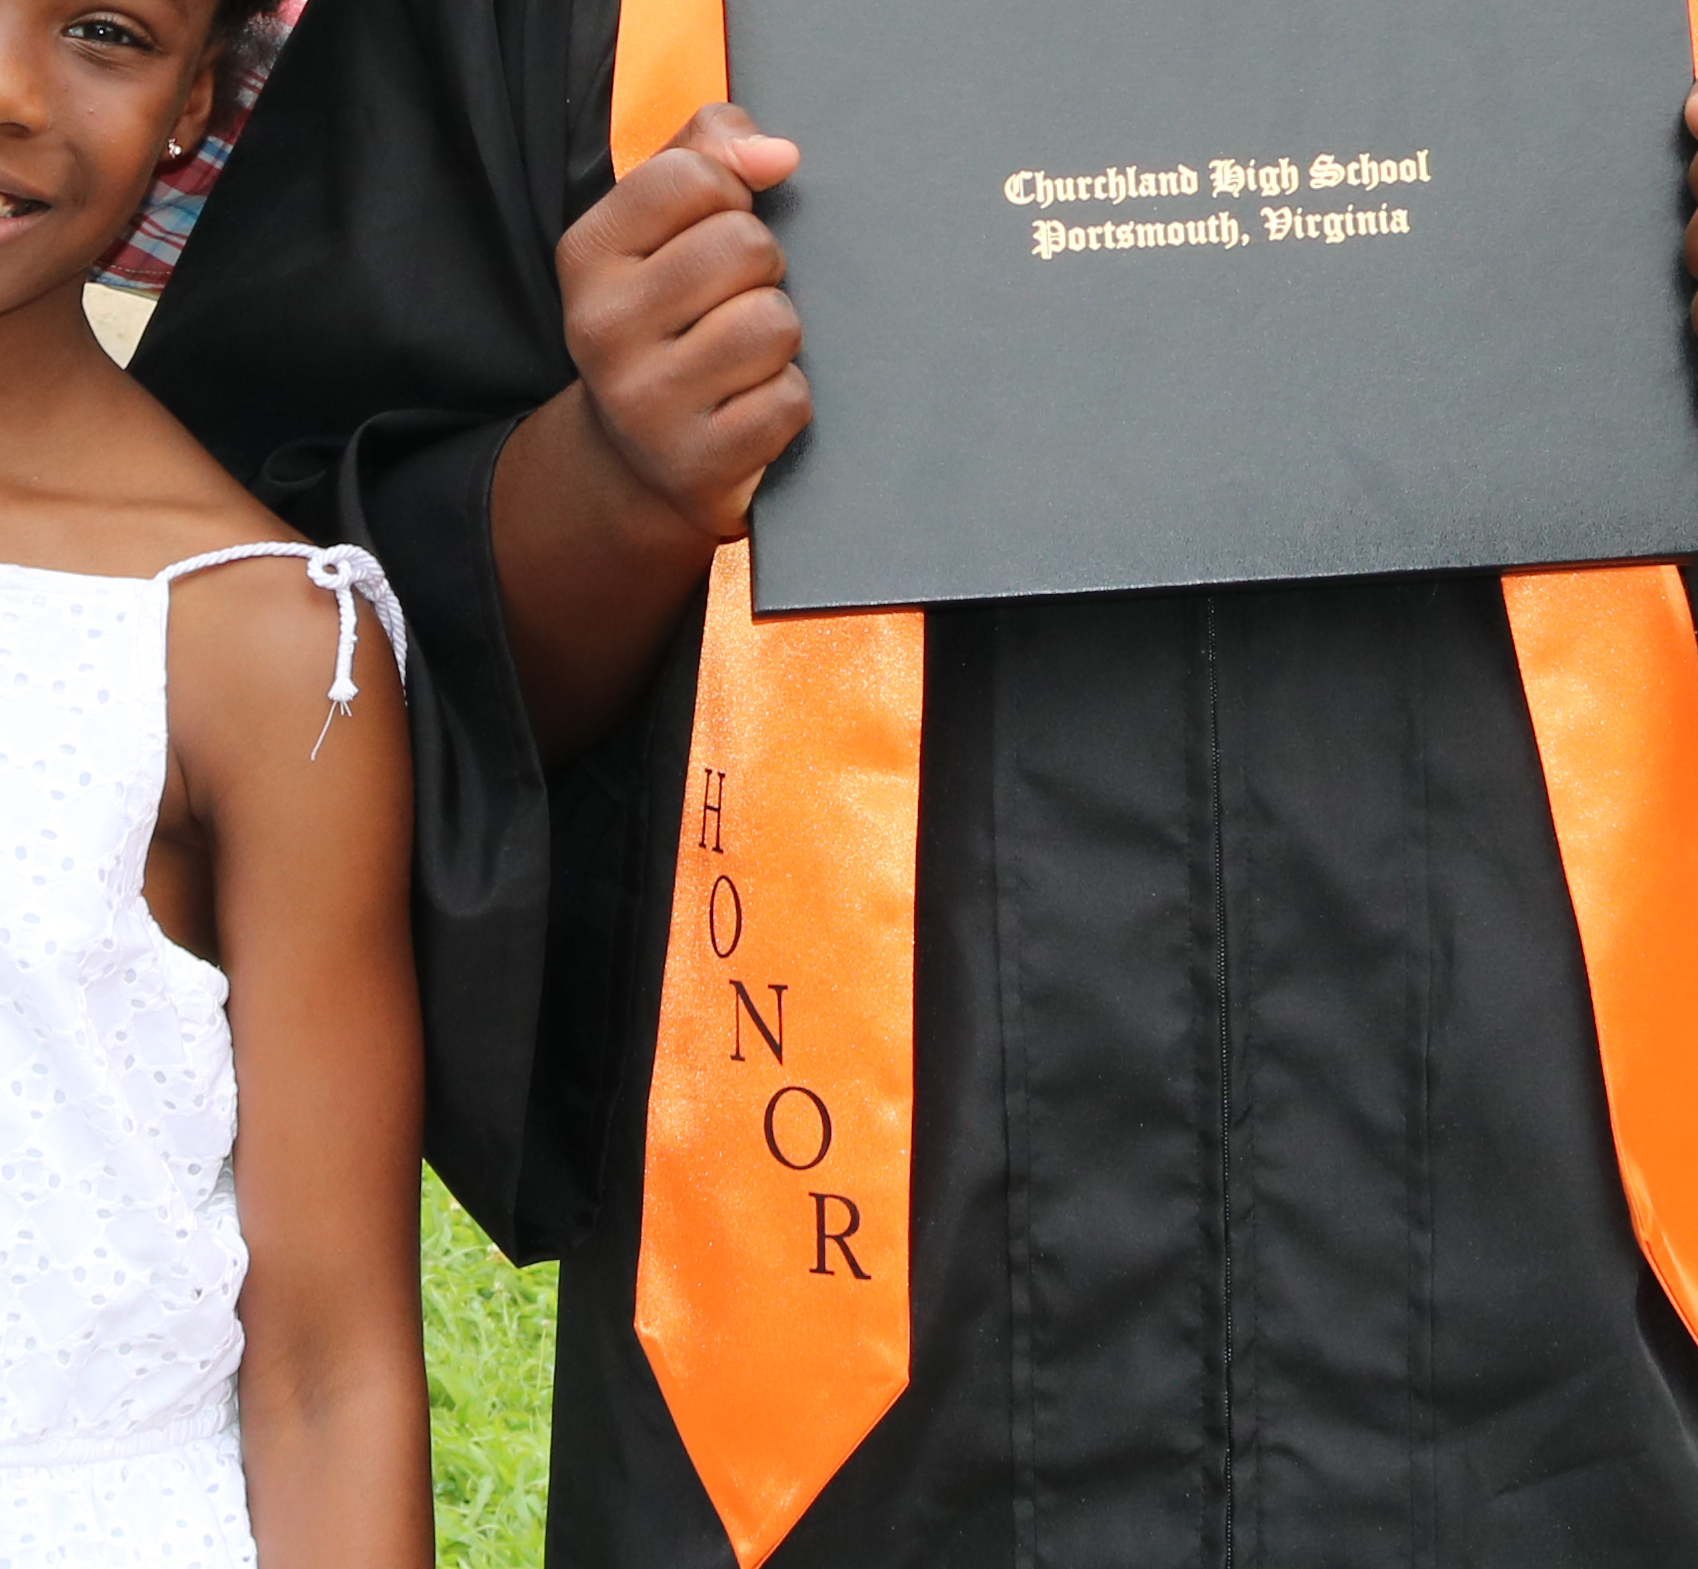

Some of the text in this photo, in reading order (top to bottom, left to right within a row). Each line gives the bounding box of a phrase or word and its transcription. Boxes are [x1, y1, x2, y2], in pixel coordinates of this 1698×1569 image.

[1002, 148, 1432, 209] Churchland High School
[1030, 203, 1411, 260] Portsmouth, Virginia
[698, 768, 871, 1280] HONOR
